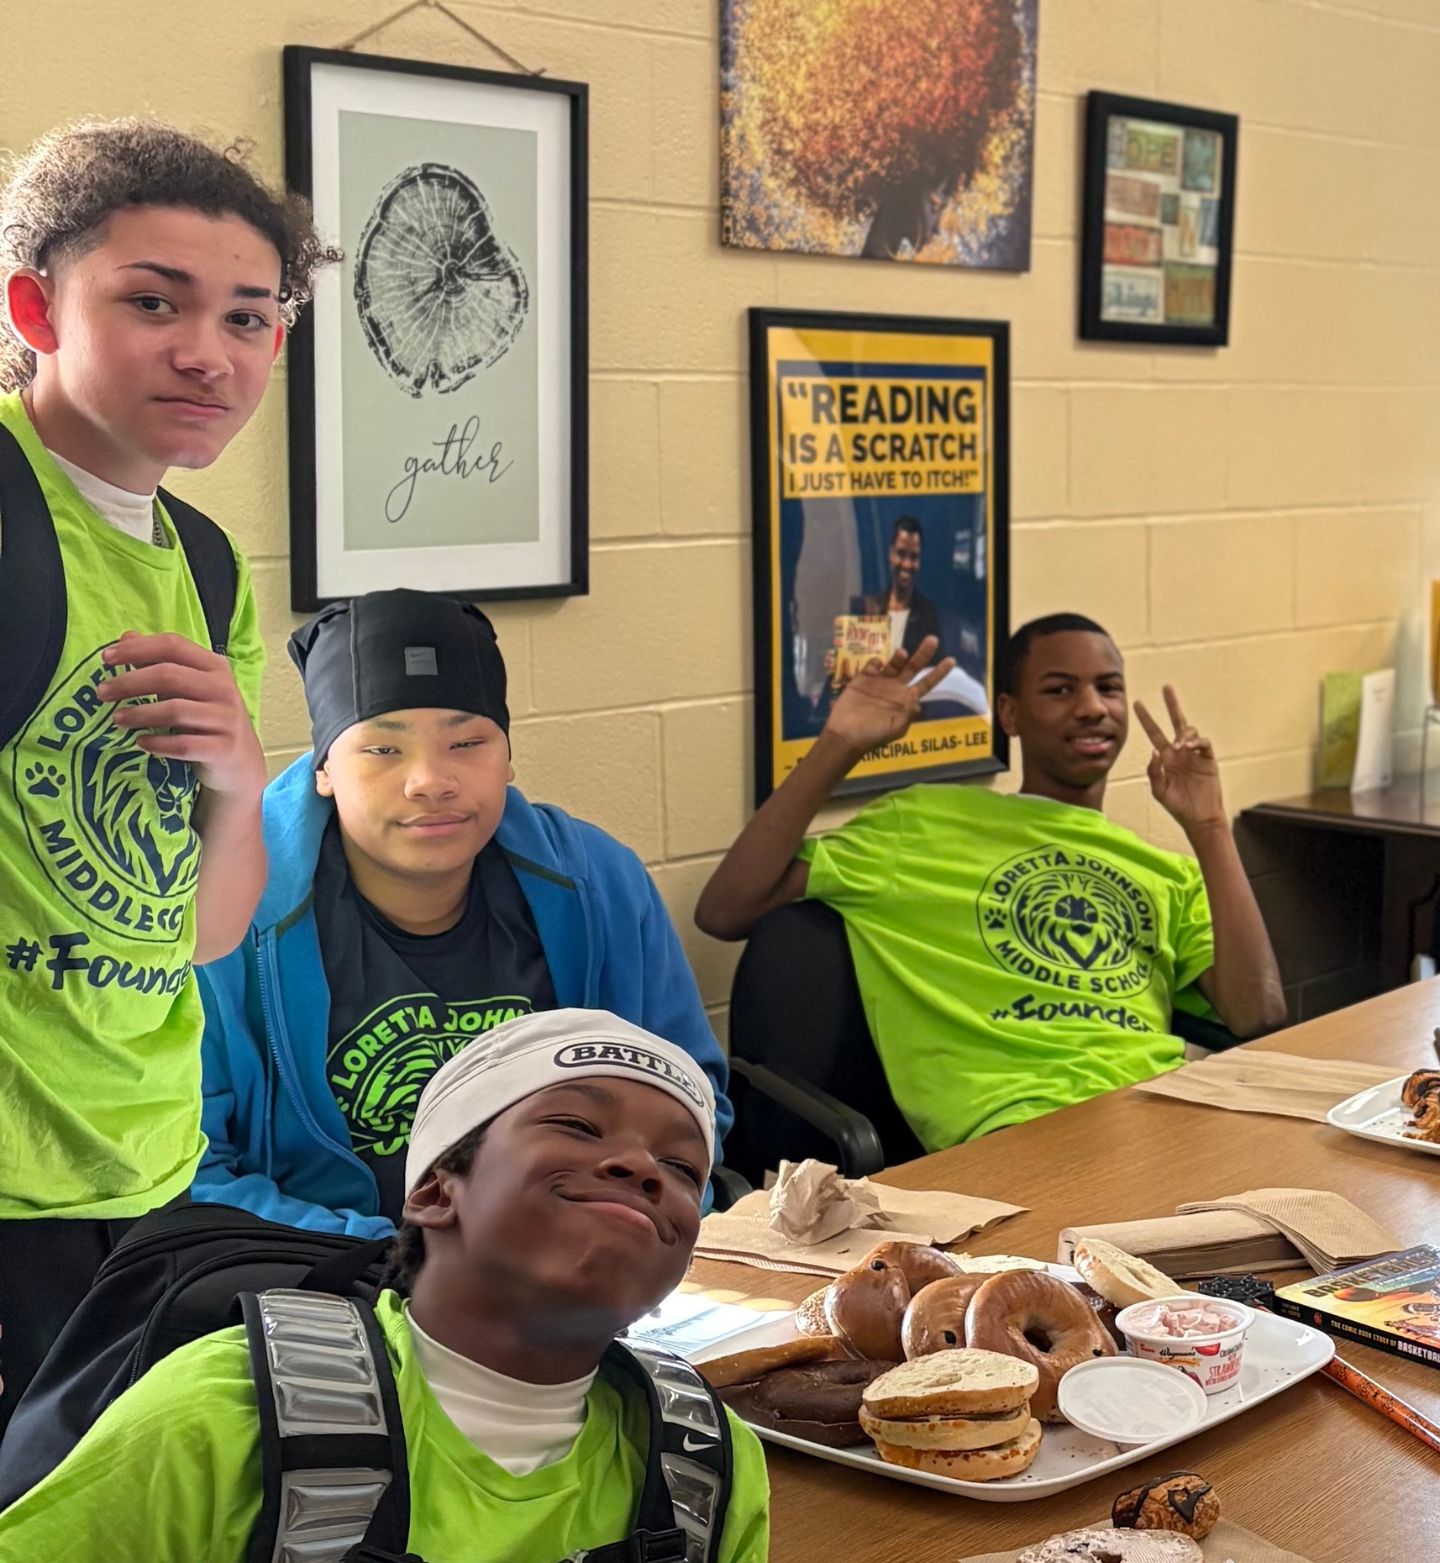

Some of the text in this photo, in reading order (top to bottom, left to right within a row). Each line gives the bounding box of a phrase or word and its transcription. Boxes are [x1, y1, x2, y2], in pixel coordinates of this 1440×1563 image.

[789, 433, 977, 464] IS A SCRATCH
[789, 473, 795, 492] I
[800, 472, 846, 491] JUST
[851, 472, 896, 490] HAVE
[901, 471, 922, 489] TO
[860, 741, 918, 762] INCIPAL
[965, 731, 988, 746] LEE
[40, 819, 153, 932] MIDDLE
[989, 851, 1153, 932] LORETTA JOHNSON
[996, 939, 1081, 991] MIDDLE
[443, 1008, 525, 1032] JOHN
[990, 993, 1161, 1034] #Founder
[1302, 1253, 1435, 1298] BASKETBALL
[1330, 1320, 1341, 1328] THE
